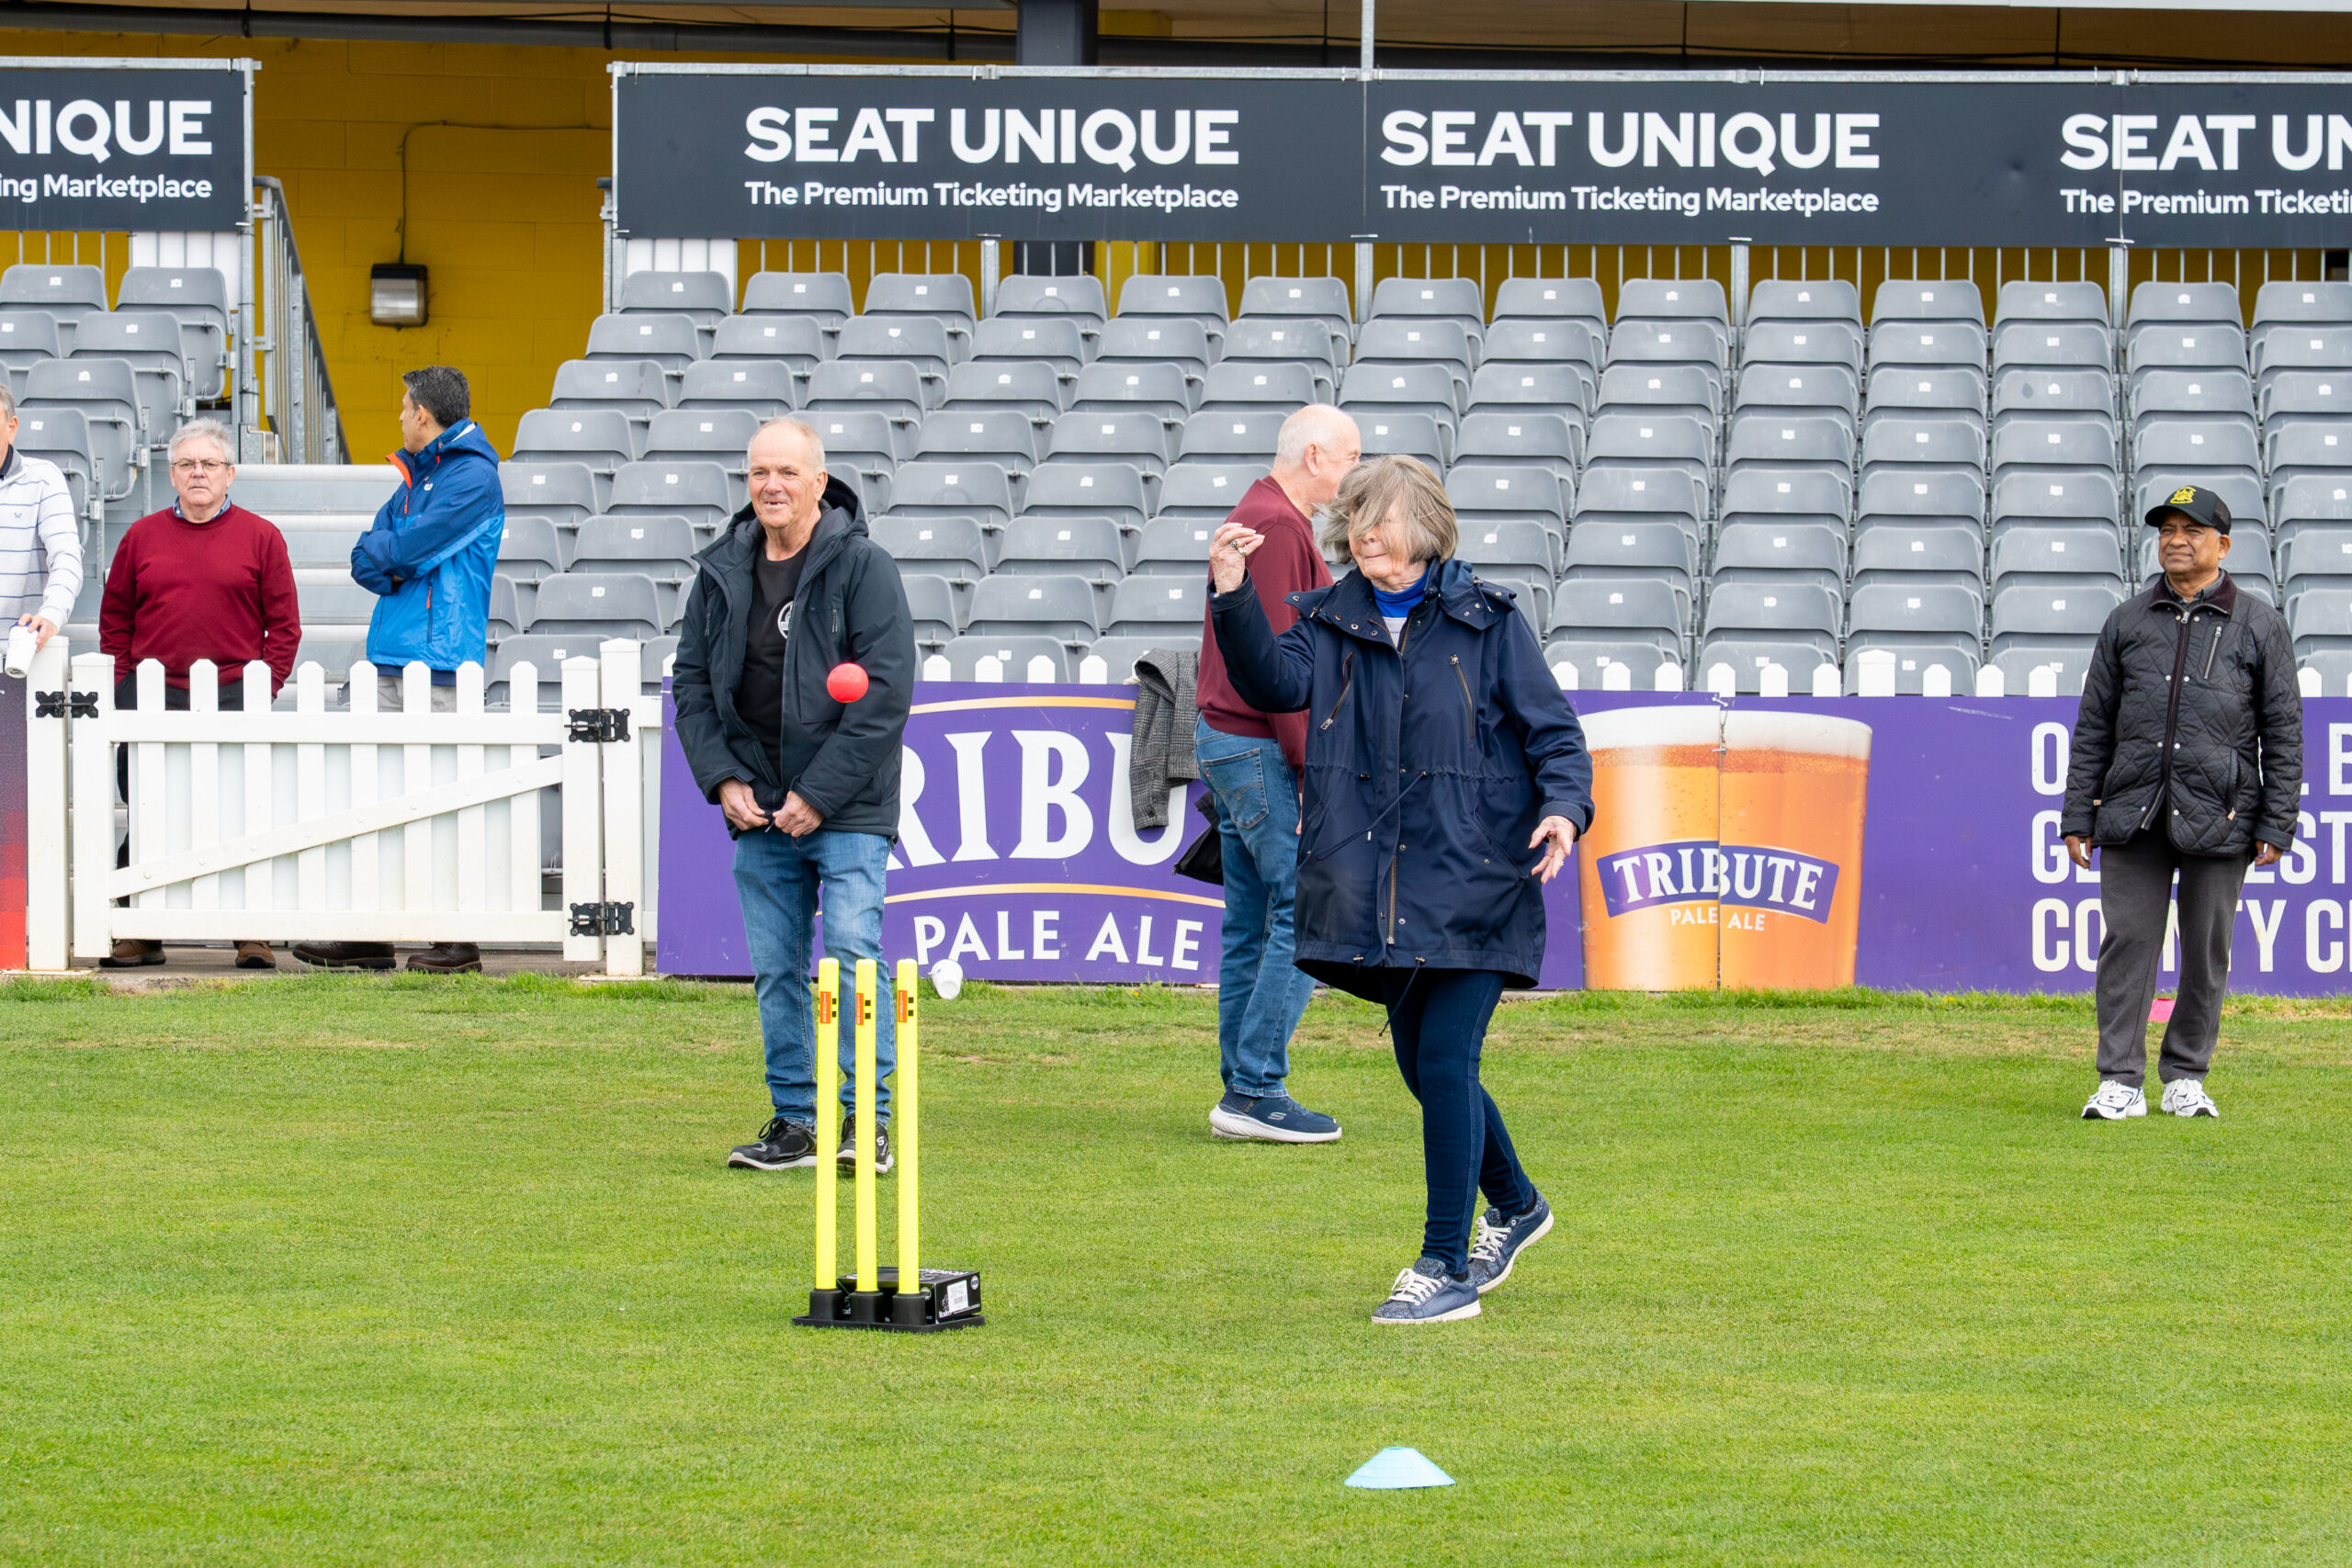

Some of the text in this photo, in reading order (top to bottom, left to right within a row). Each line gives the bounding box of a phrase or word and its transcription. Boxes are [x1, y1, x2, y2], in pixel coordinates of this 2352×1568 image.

[744, 107, 1239, 173] SEAT UNIQUE
[1381, 110, 1880, 176] SEAT UNIQUE
[2061, 114, 2256, 170] SEAT
[43, 174, 212, 204] Marketplace
[745, 181, 1239, 213] The Premium Ticketing Marketplace
[1381, 185, 1880, 217] The Premium Ticketing Marketplace
[2061, 189, 2352, 214] The Premium Ticketi
[1612, 848, 1824, 910] TRIBUTE
[914, 910, 1204, 971] PALE ALE
[1670, 907, 1766, 931] PALE ALE
